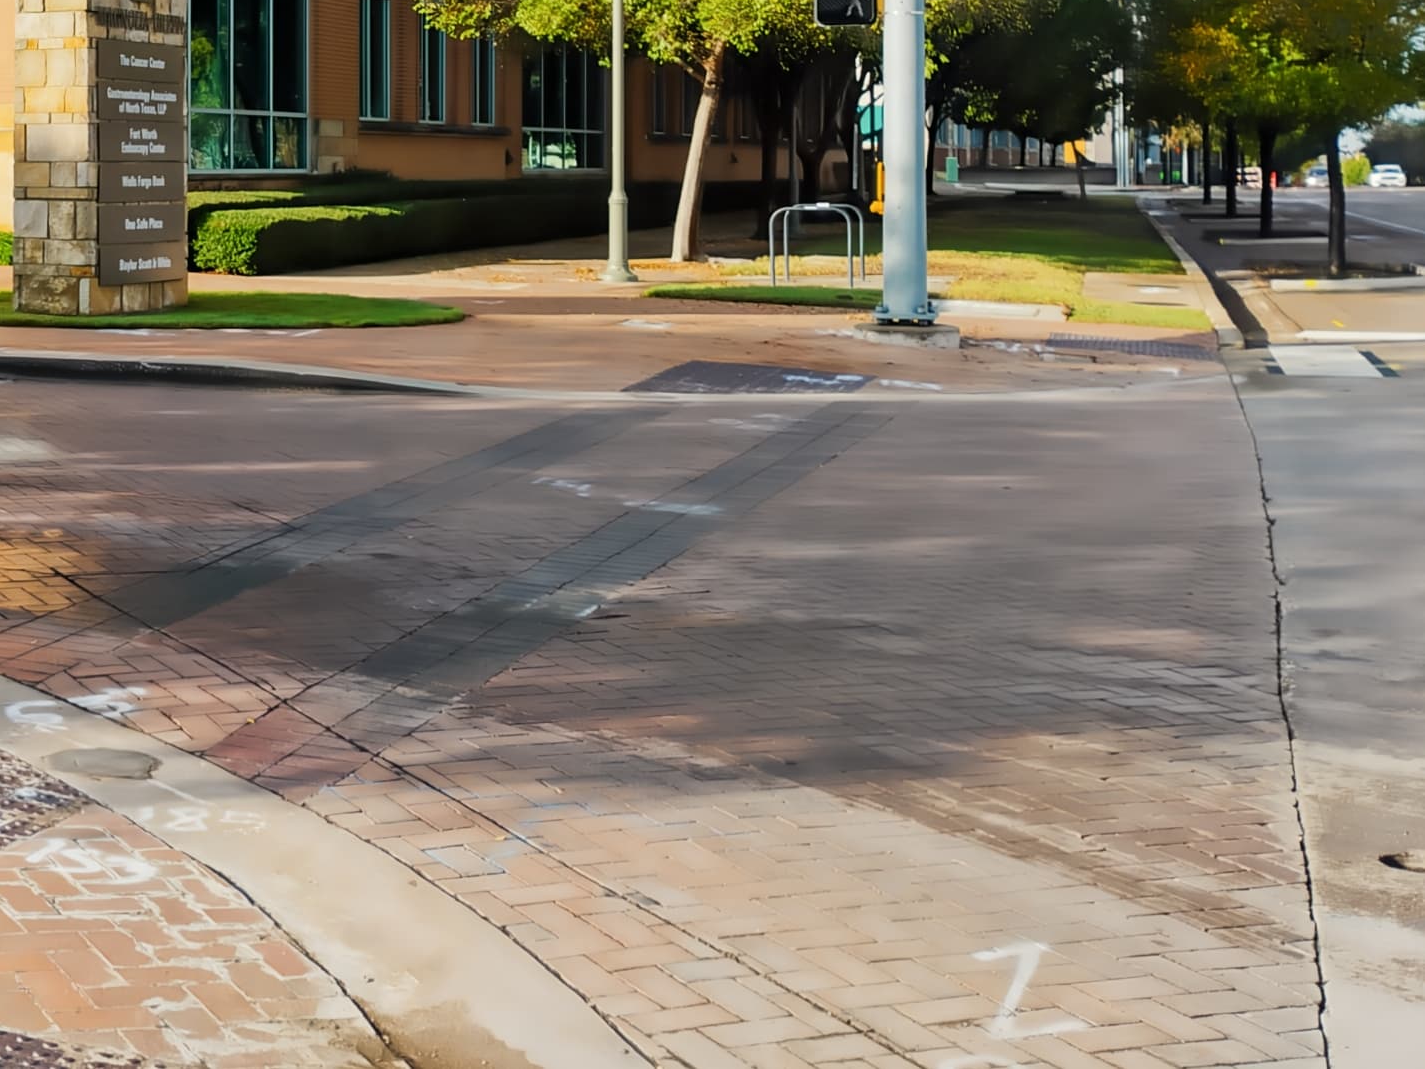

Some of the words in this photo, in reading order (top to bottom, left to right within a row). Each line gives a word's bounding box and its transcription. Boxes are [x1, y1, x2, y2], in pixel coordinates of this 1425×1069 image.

[121, 175, 138, 187] Wells
[137, 175, 152, 189] Fargo
[151, 175, 166, 187] Bank
[124, 218, 136, 231] One
[136, 217, 149, 230] Safe
[148, 217, 164, 230] Place
